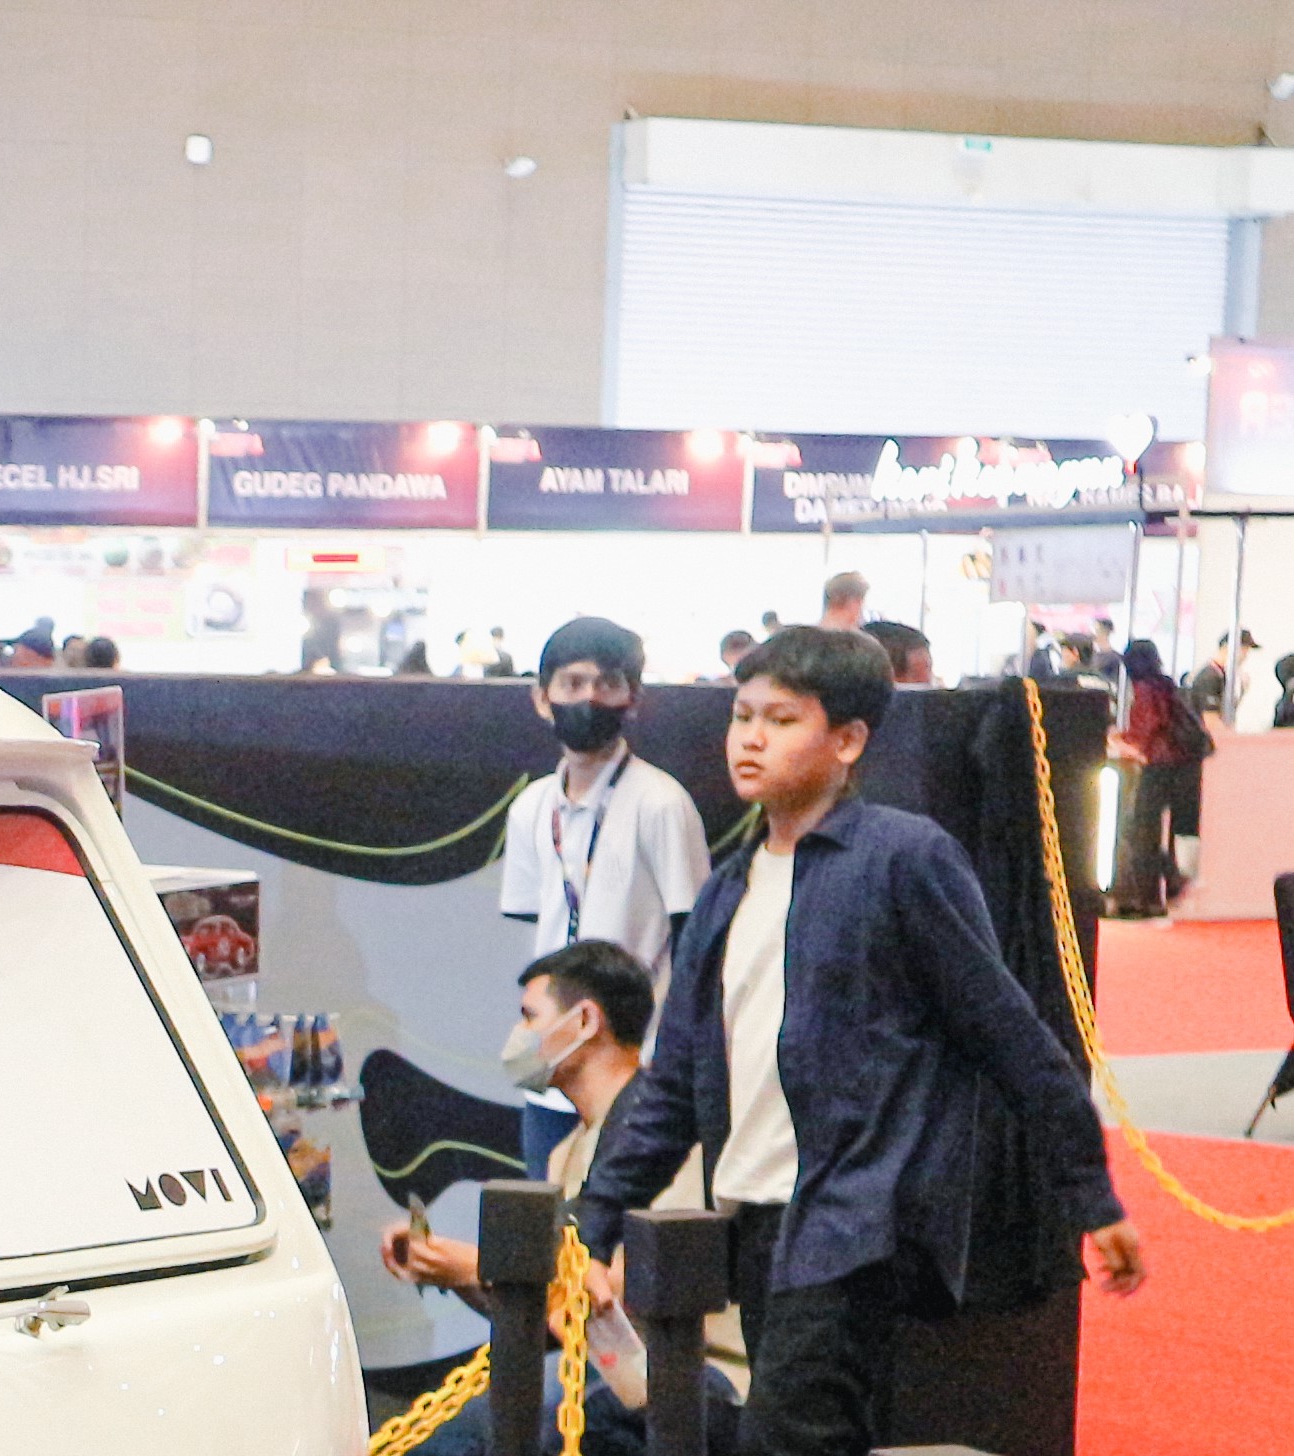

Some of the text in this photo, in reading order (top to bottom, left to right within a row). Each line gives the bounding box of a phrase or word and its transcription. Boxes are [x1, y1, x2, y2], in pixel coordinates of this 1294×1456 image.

[233, 470, 447, 500] GUDEG PANDAWA
[539, 466, 605, 494] AYAM
[125, 1168, 233, 1211] MOVI
